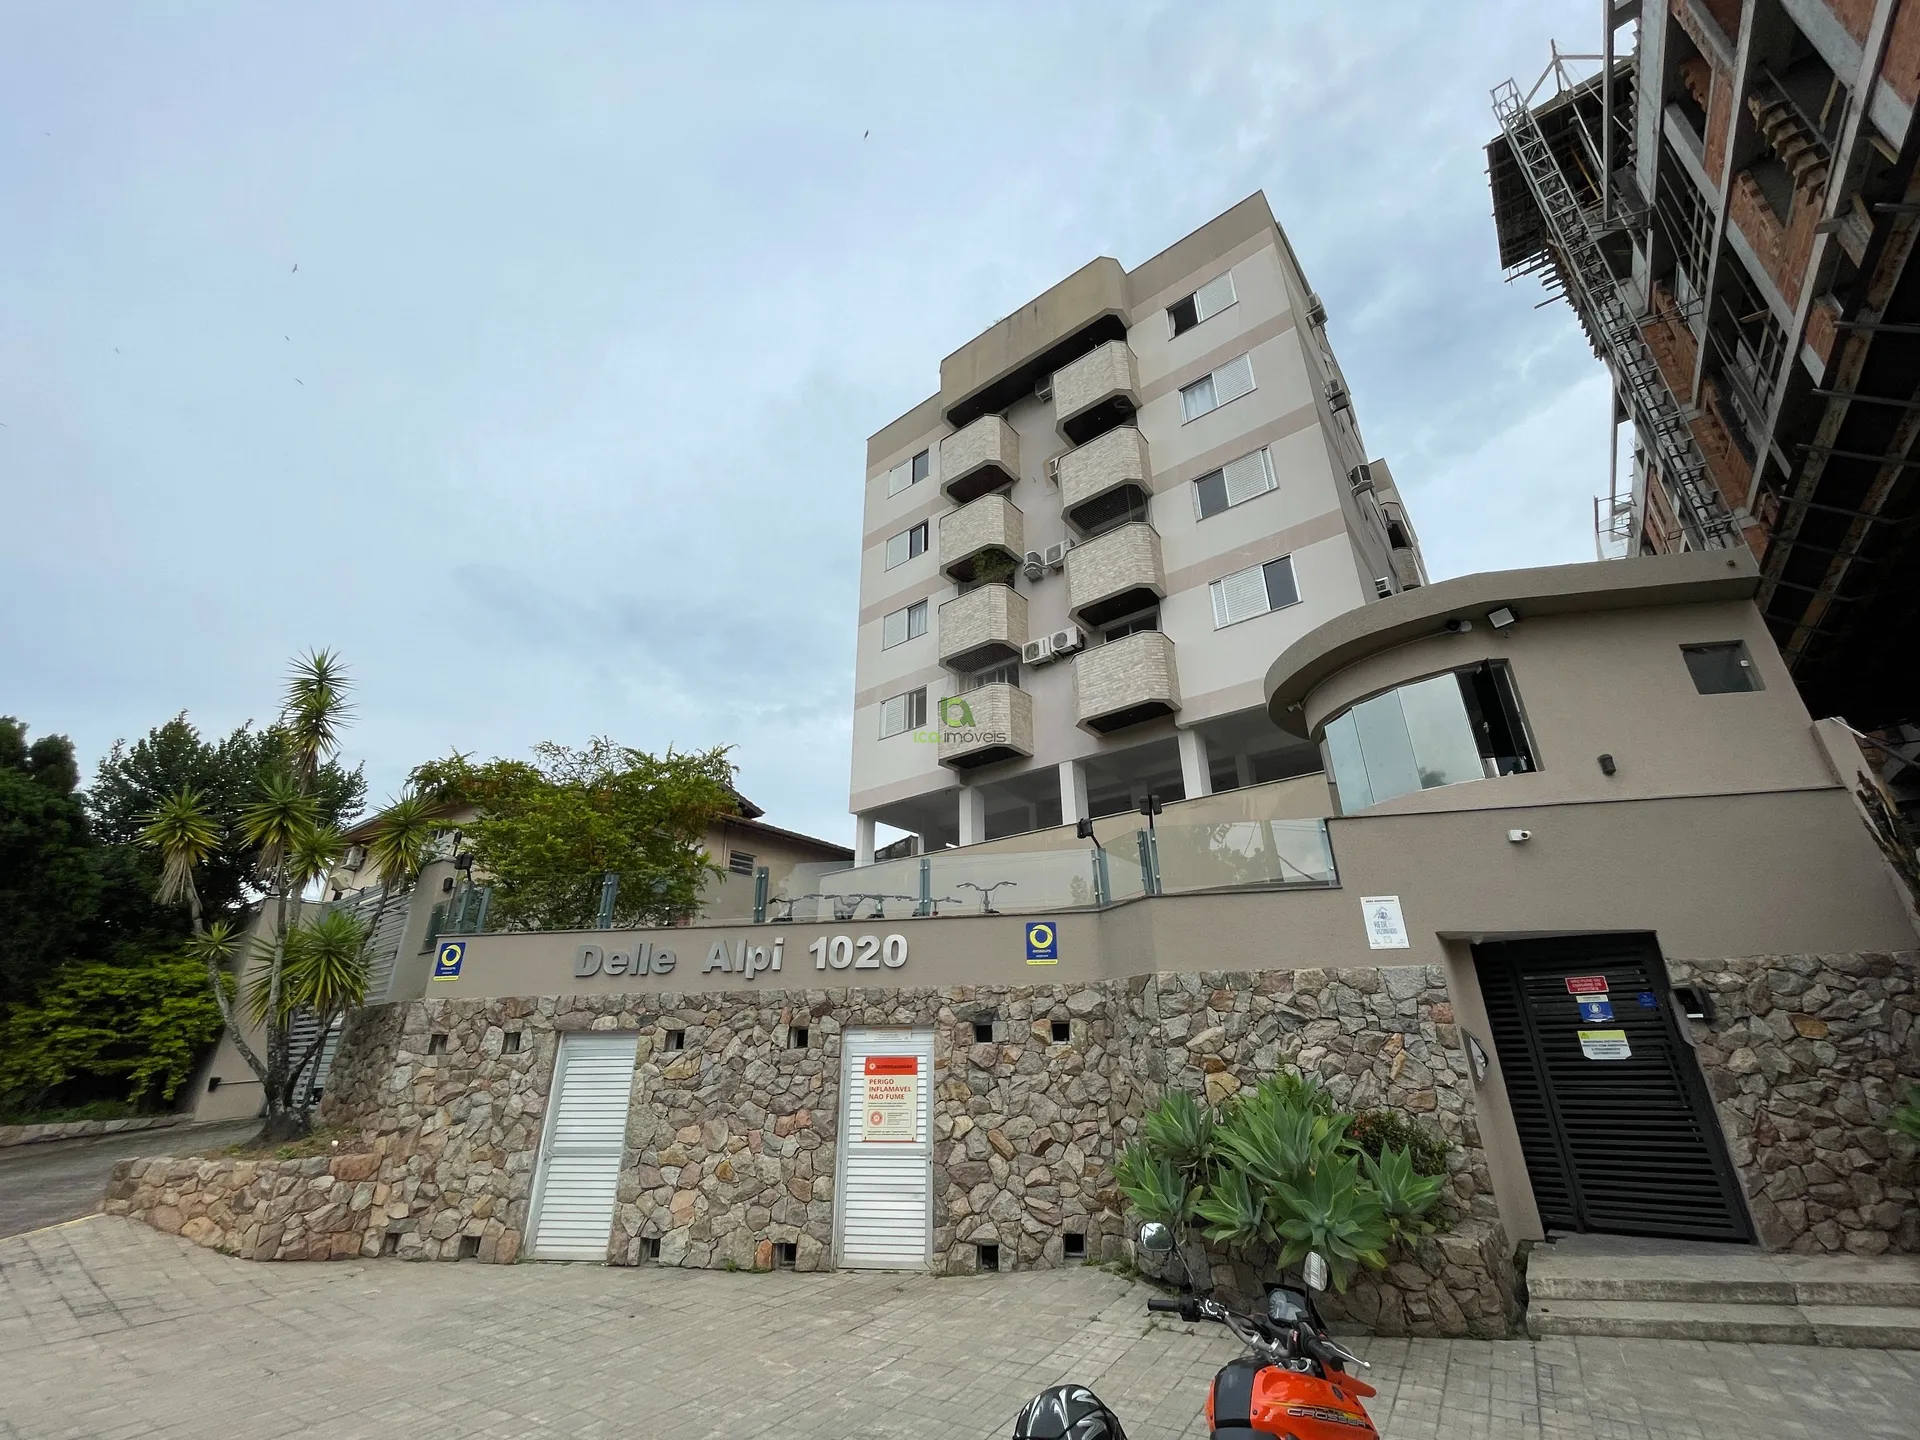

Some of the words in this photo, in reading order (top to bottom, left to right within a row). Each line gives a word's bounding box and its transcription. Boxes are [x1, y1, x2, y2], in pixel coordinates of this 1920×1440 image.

[574, 942, 677, 977] Delle
[701, 937, 785, 979] Alpi
[808, 933, 909, 969] 1020
[1287, 1408, 1367, 1428] CROSSER
